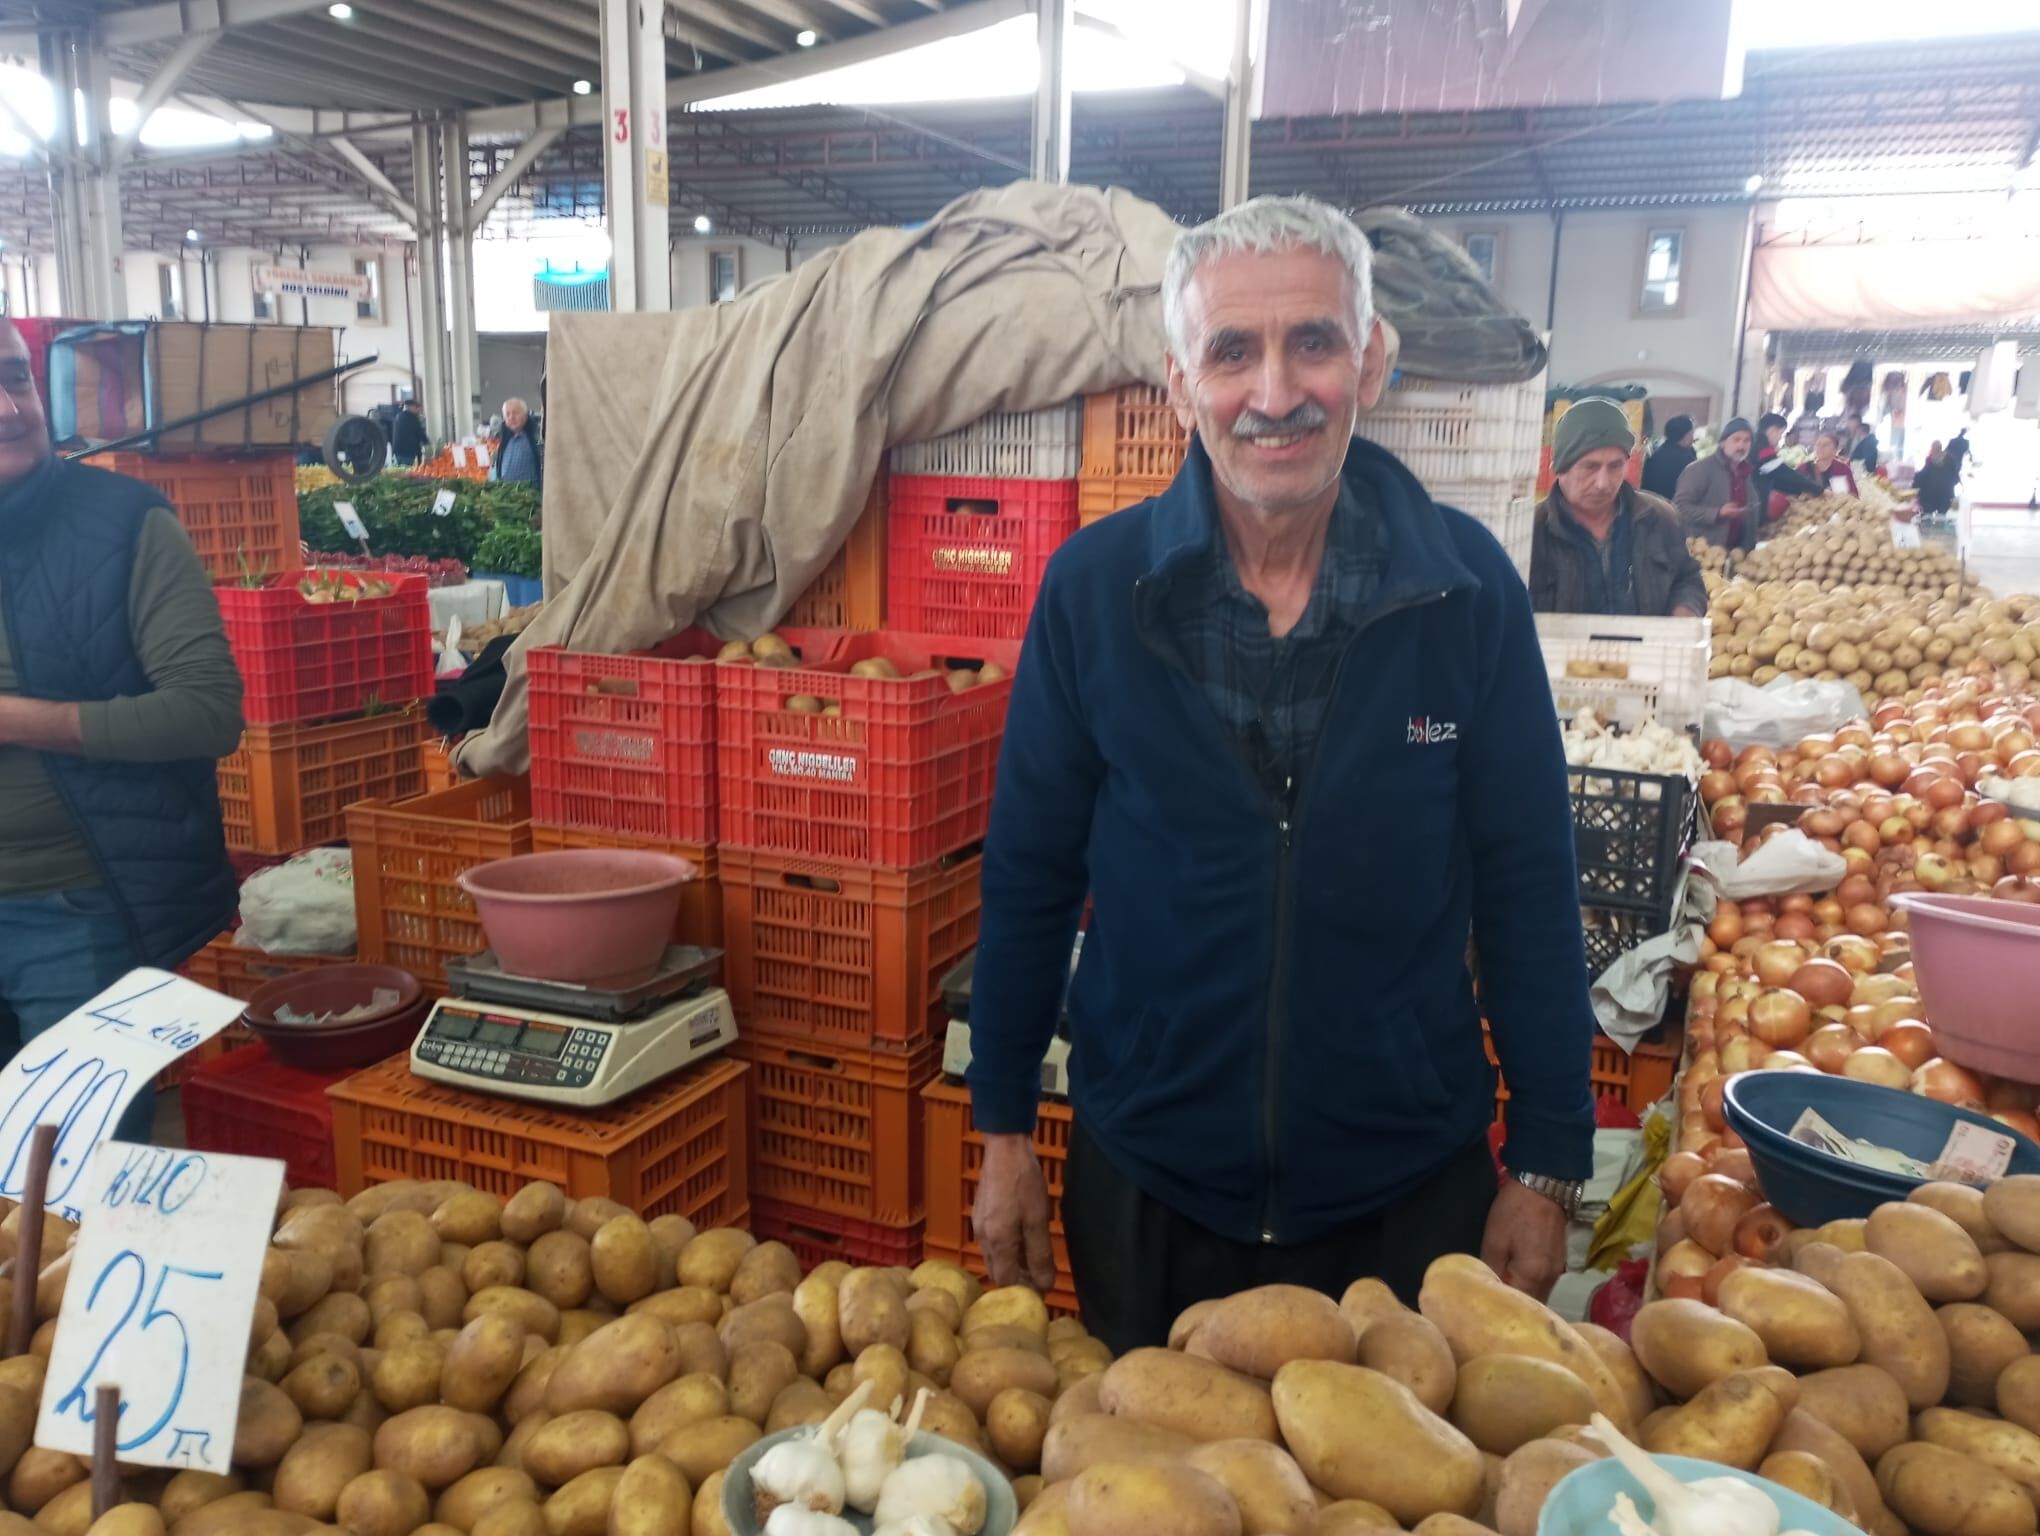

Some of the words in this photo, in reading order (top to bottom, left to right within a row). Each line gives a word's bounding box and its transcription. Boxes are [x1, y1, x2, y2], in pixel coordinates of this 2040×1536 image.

[614, 109, 628, 143] 3
[650, 109, 660, 144] 3
[53, 1249, 223, 1450] 25
